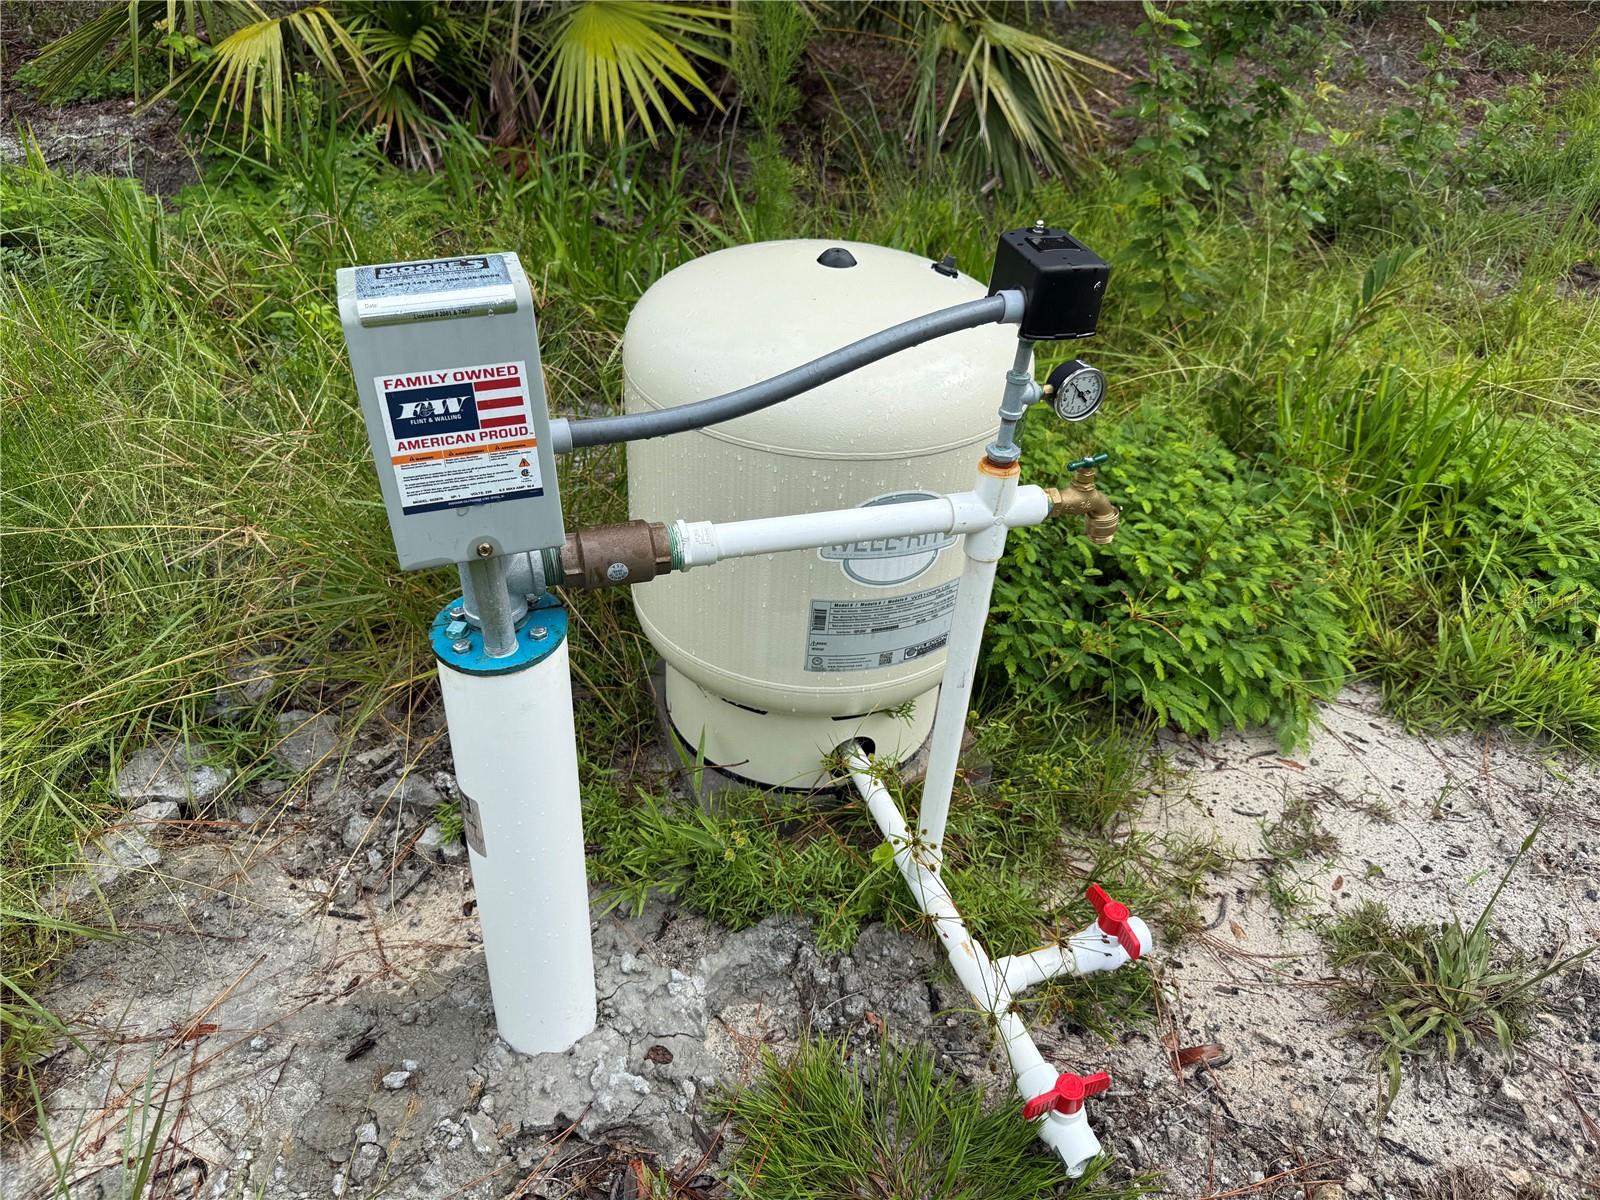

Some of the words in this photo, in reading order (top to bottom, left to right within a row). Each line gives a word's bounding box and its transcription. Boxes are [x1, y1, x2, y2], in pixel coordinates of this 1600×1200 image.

[379, 260, 485, 275] MOORE'S
[383, 373, 448, 390] FAMILY
[453, 365, 518, 382] OWNED
[434, 413, 462, 423] WALLING
[397, 432, 475, 452] AMERICAN
[479, 426, 528, 442] PROUD
